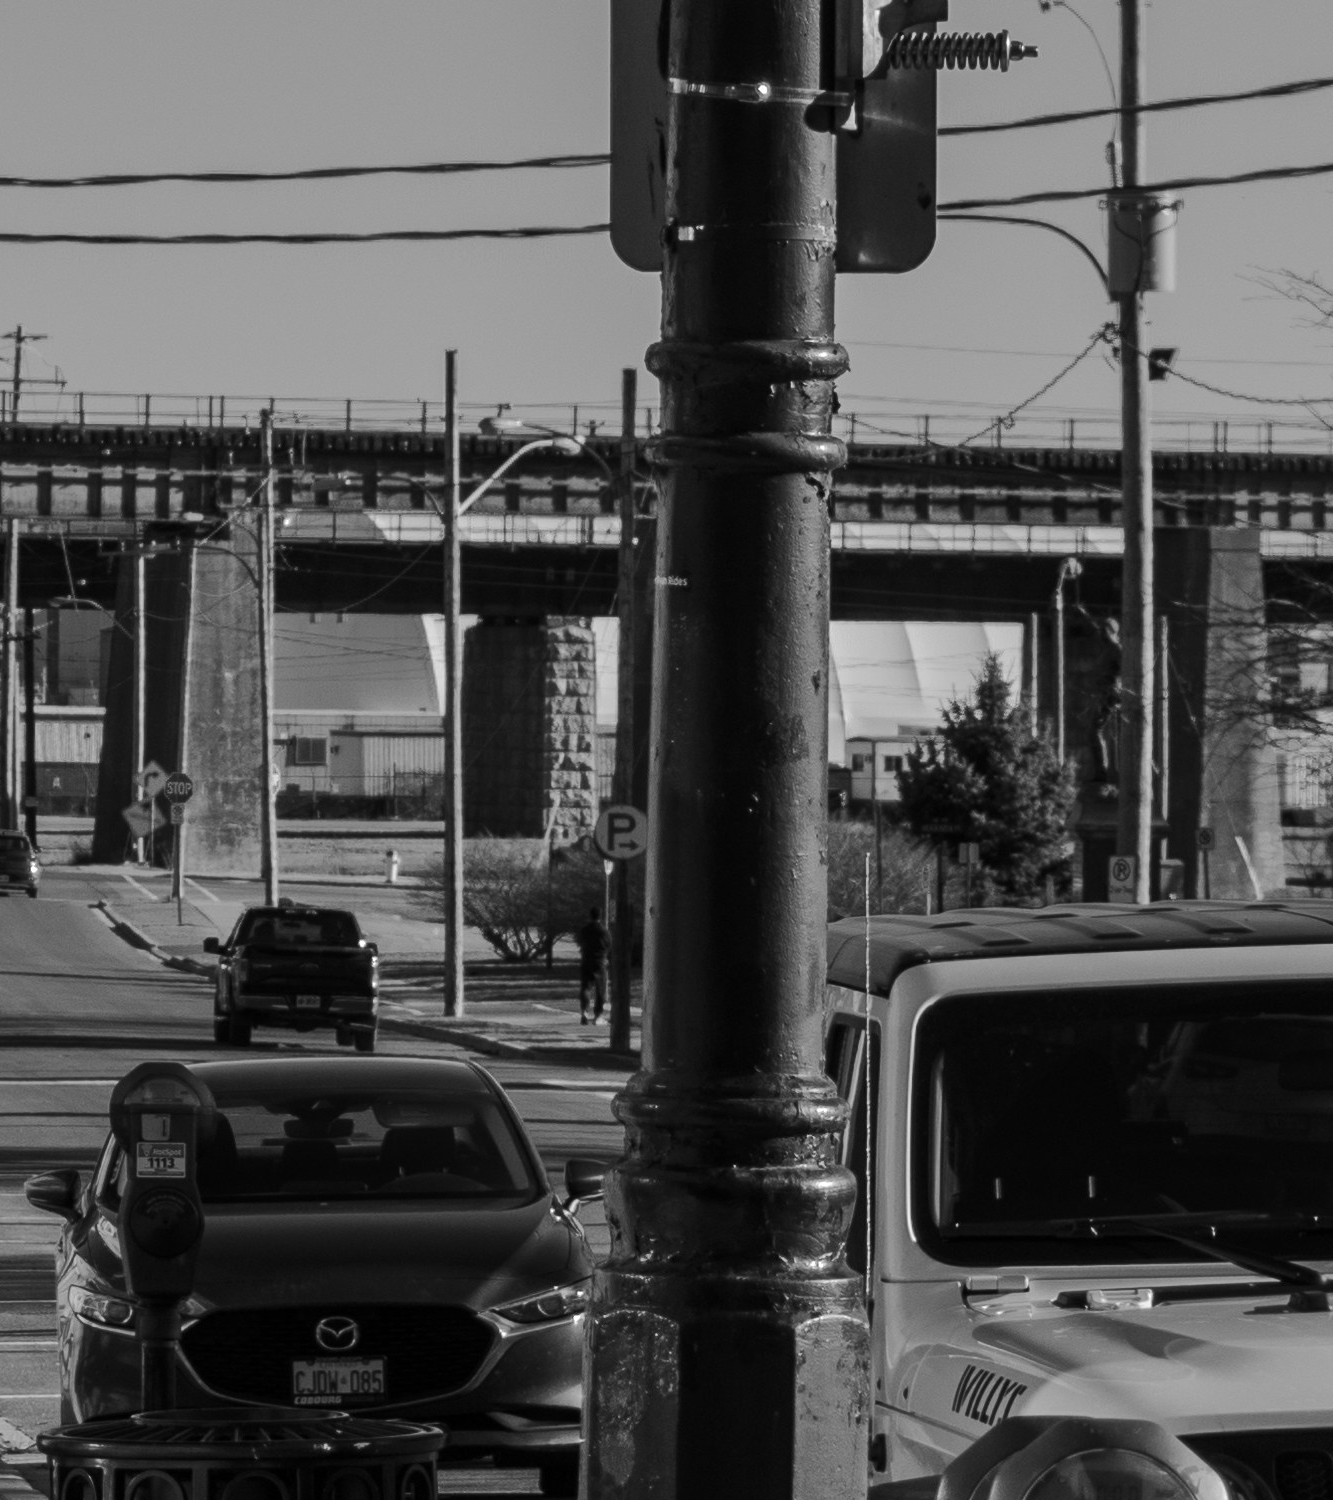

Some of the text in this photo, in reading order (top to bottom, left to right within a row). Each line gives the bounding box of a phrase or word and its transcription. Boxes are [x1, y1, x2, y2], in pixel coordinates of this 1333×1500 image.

[166, 781, 193, 795] STOP
[607, 812, 637, 852] P
[146, 1157, 175, 1169] 1113
